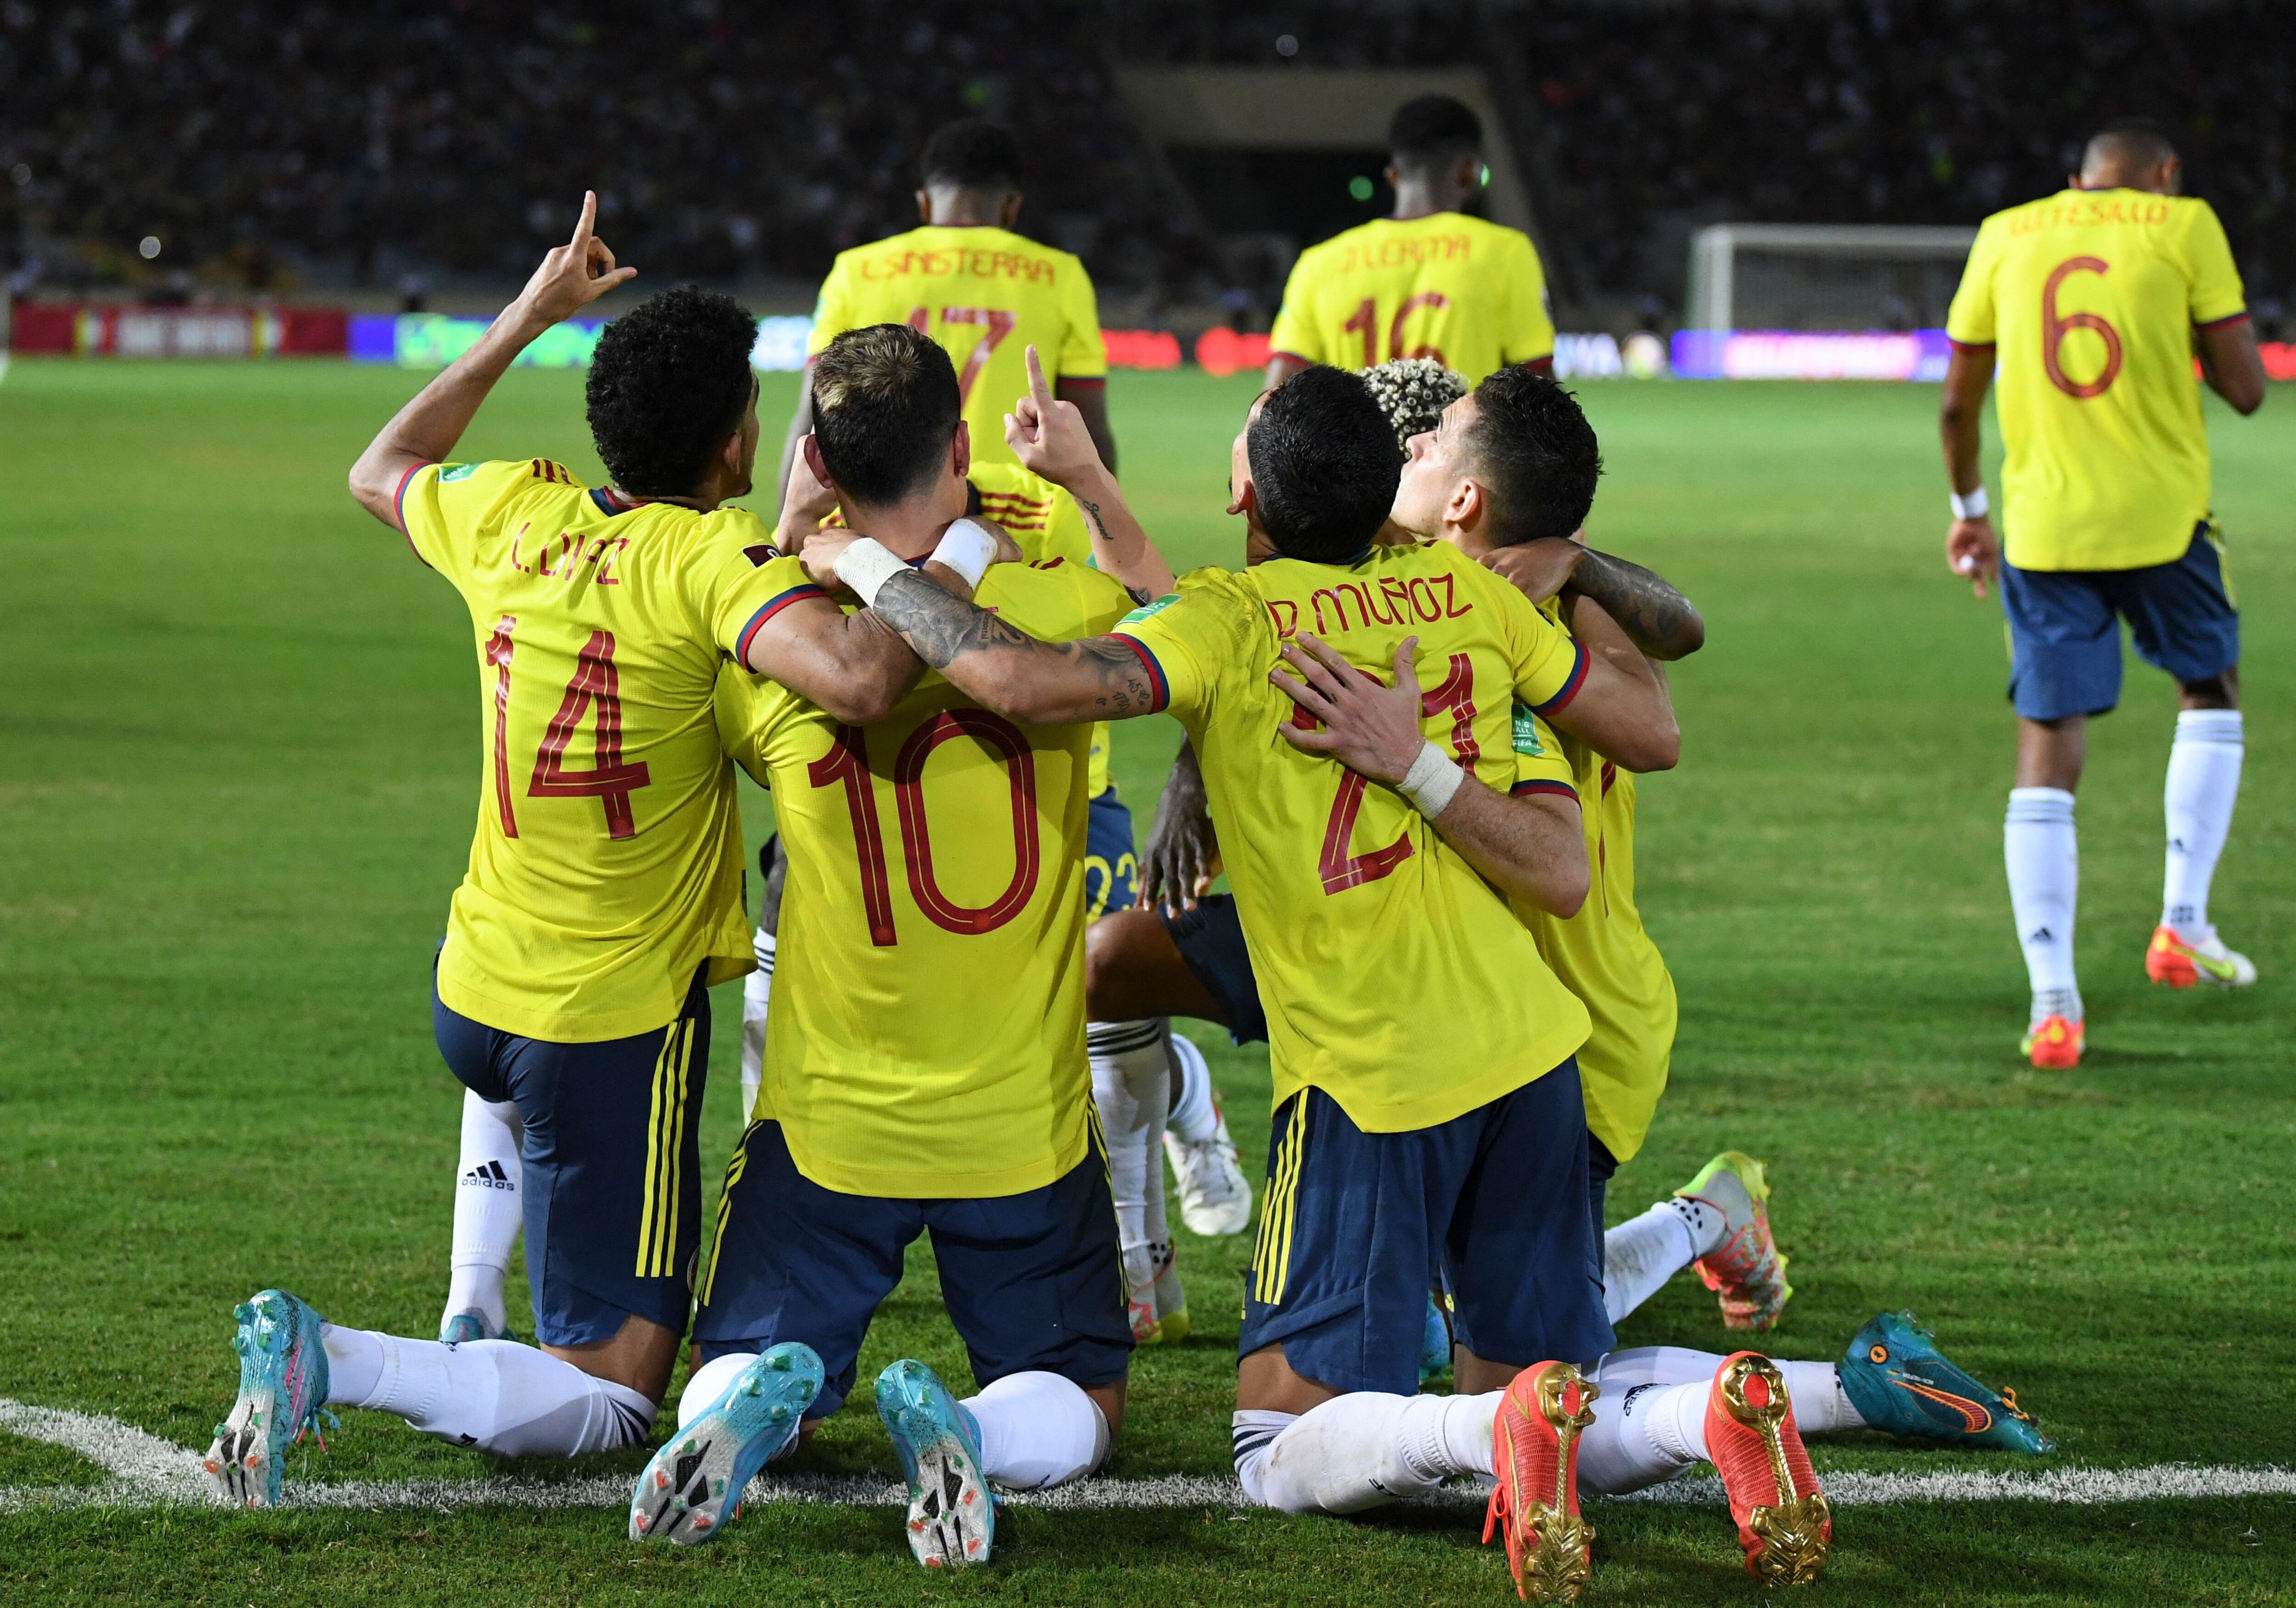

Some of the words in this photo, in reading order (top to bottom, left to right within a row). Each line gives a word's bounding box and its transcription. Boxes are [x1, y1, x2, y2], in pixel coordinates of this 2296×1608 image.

[2043, 256, 2123, 399] 6
[485, 614, 651, 840] 14
[807, 707, 1040, 947] 10
[1291, 652, 1481, 897] 21
[462, 1176, 514, 1191] adidas
